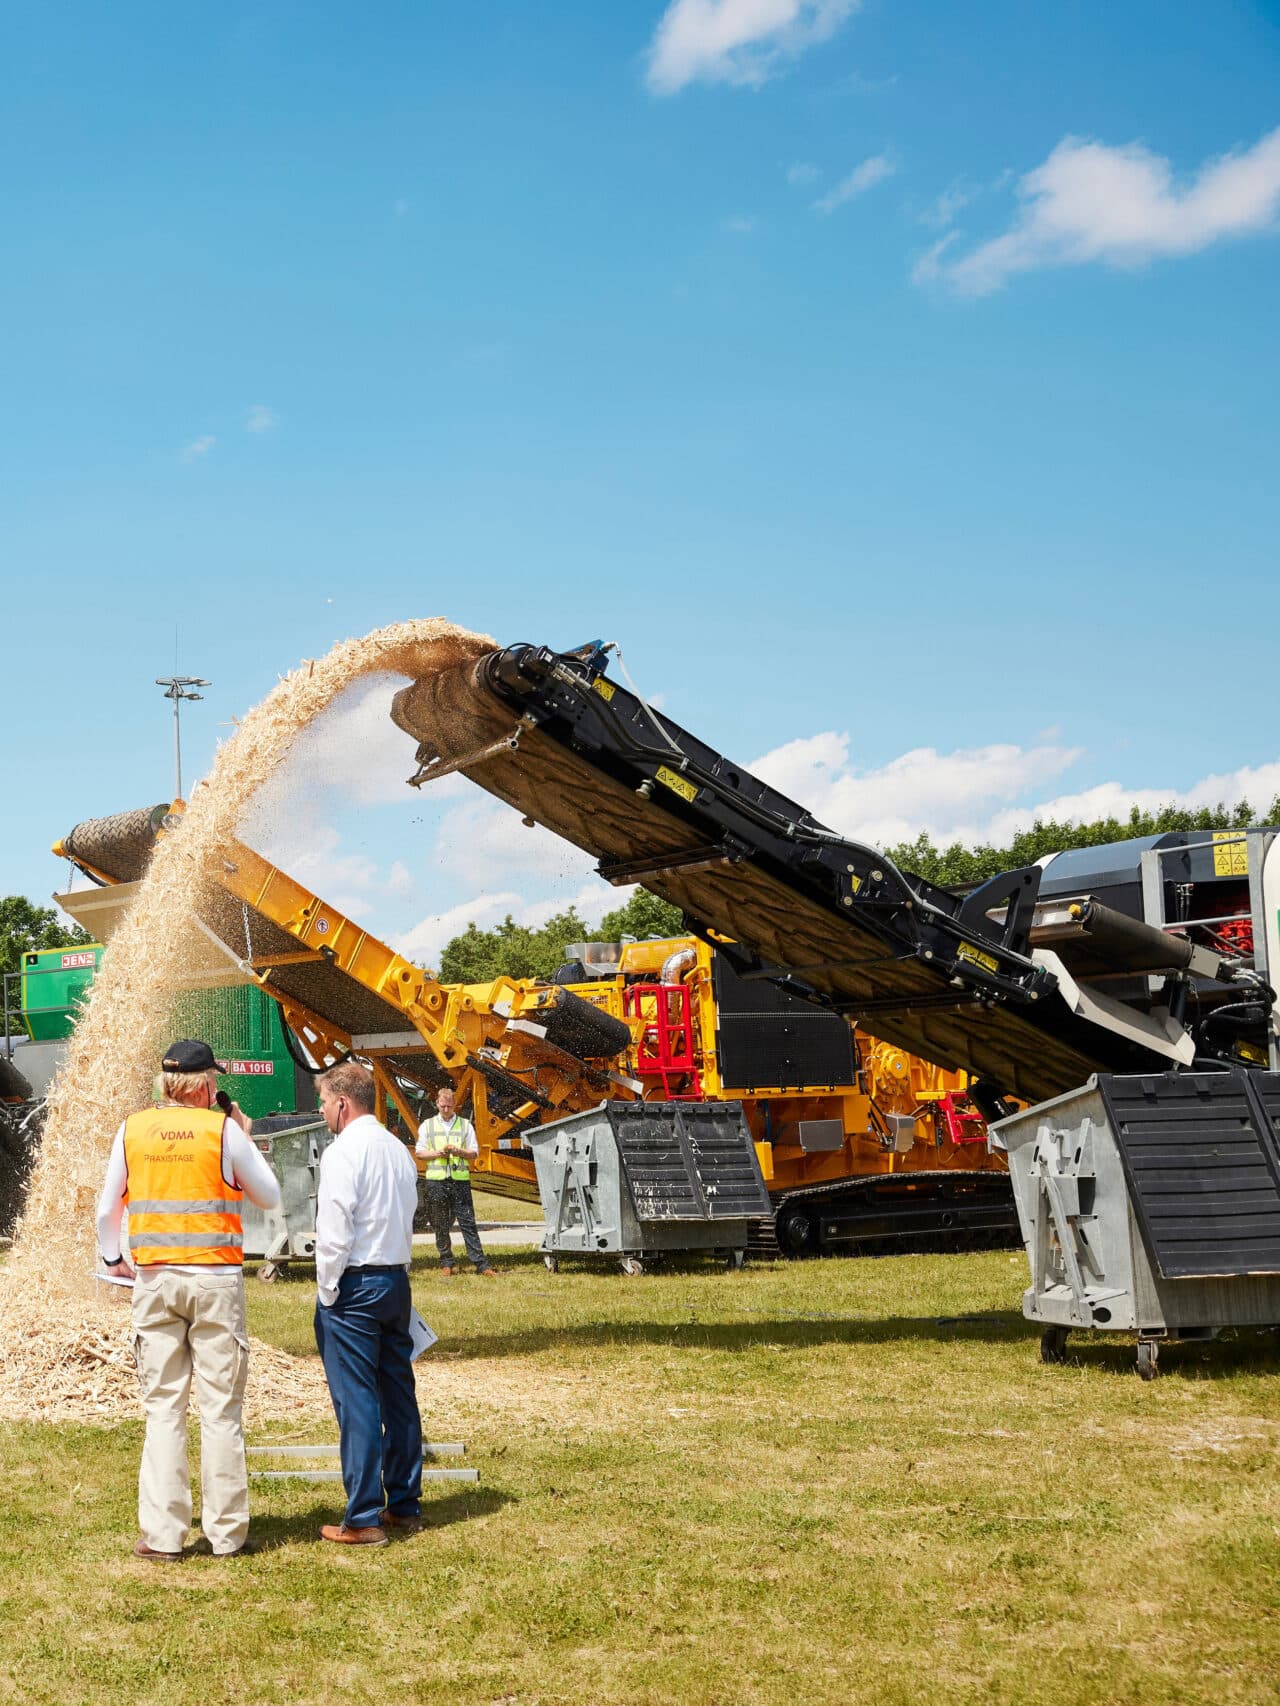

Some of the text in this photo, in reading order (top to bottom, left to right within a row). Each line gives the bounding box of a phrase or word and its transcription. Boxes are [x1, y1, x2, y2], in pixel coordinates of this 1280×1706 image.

[63, 954, 93, 967] JENZ
[233, 1063, 246, 1073] BA
[249, 1063, 272, 1073] 1016
[160, 1131, 194, 1140] VDMA
[144, 1154, 195, 1163] PRAXISTAGE
